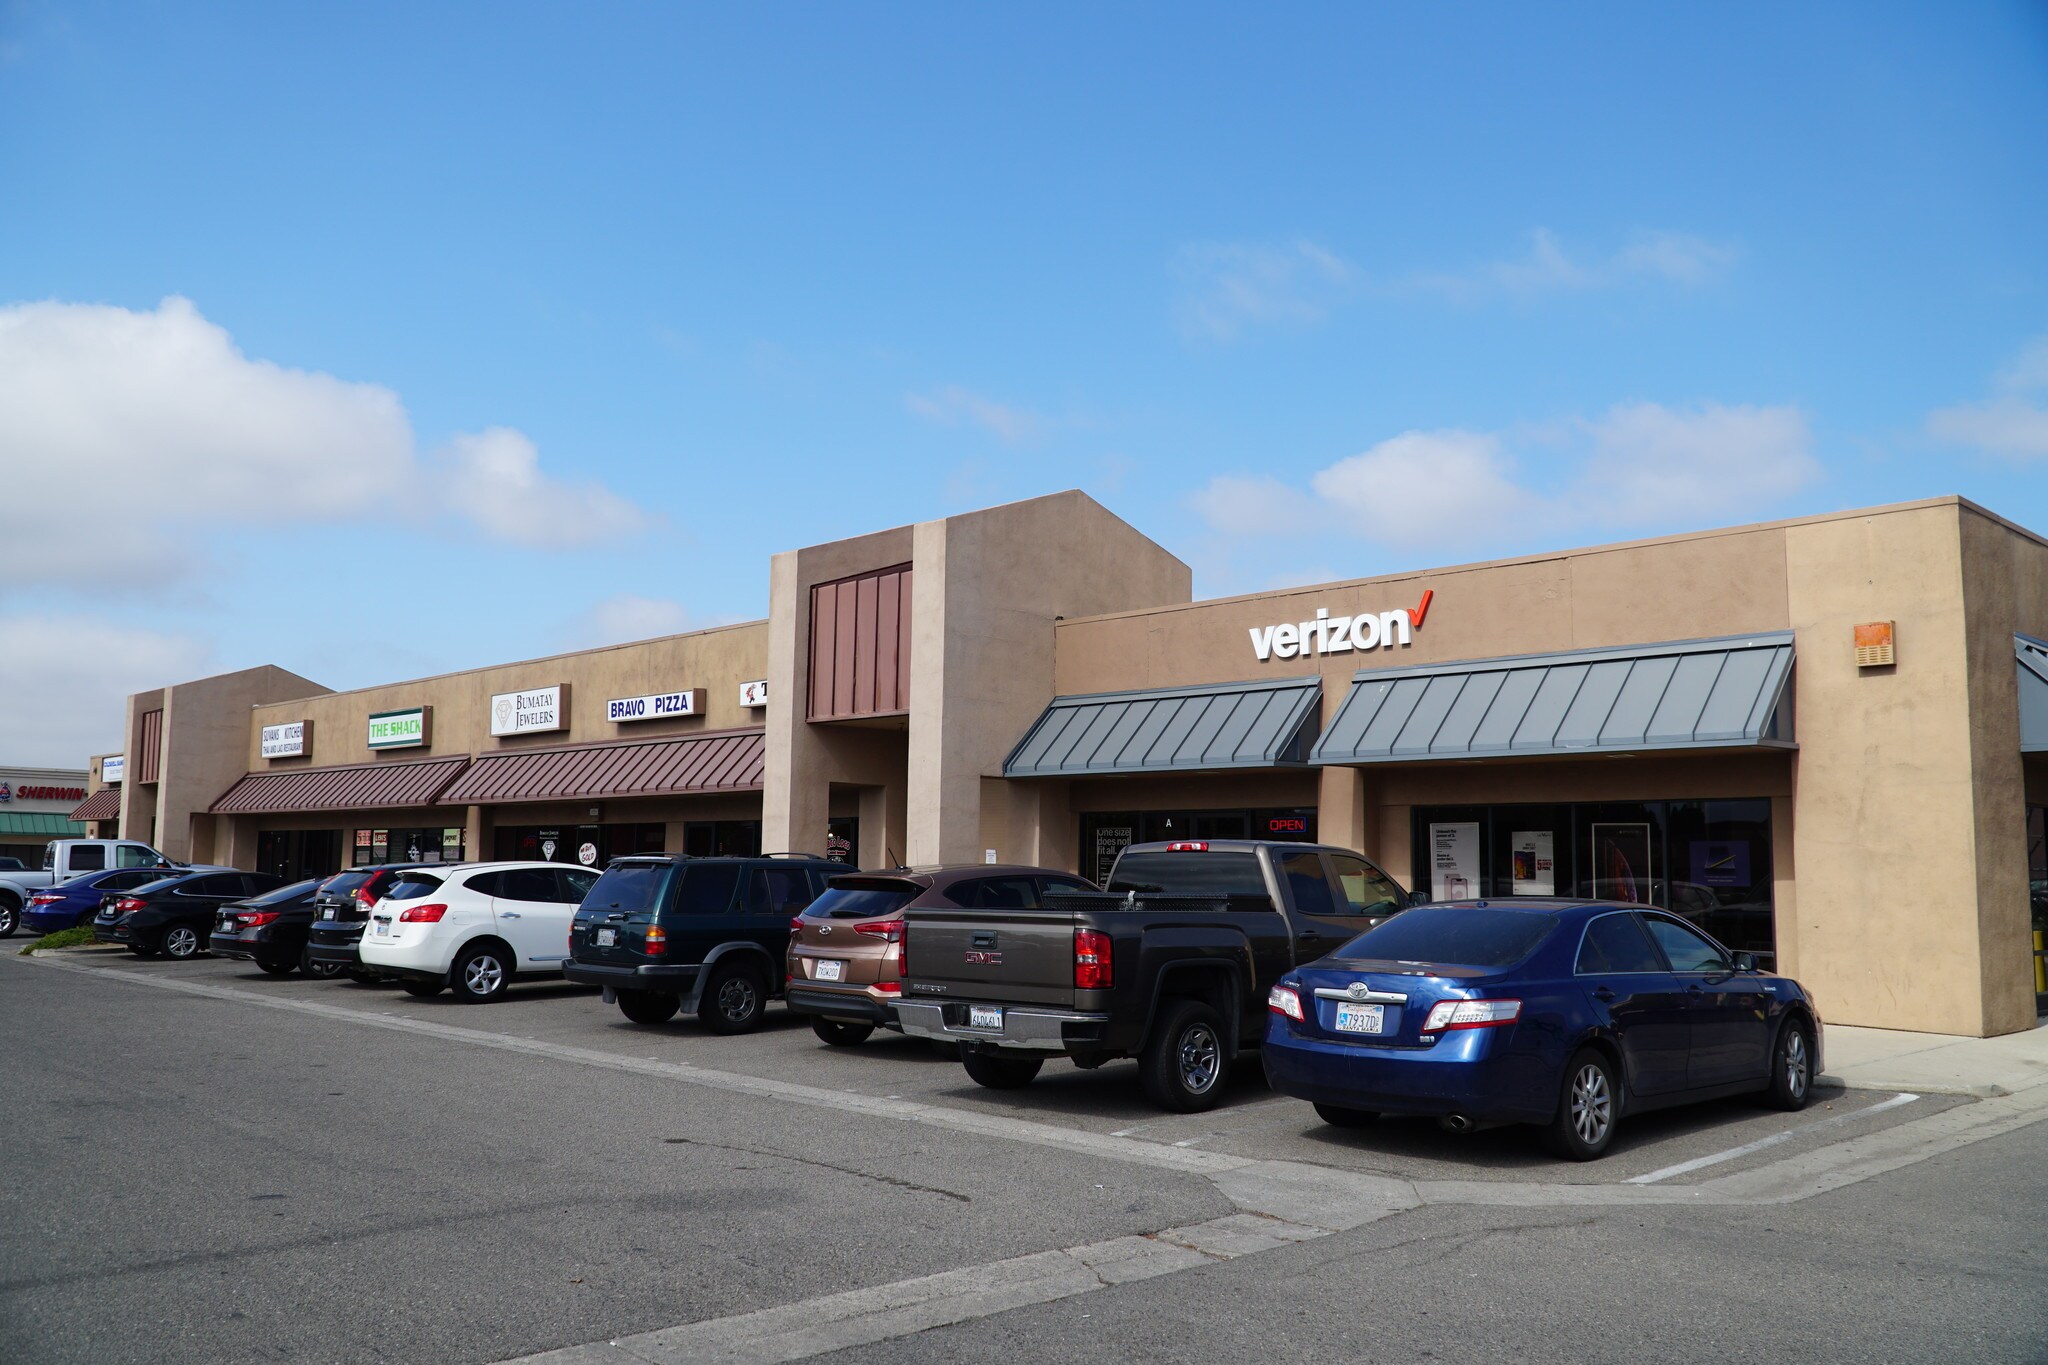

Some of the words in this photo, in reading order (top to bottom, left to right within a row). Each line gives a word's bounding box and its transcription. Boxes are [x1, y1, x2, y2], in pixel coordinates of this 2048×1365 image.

[1249, 608, 1412, 660] verizon
[516, 694, 553, 710] BUMATAY
[611, 699, 645, 718] BRAVO
[655, 694, 688, 714] PIZZA
[515, 711, 554, 730] JEWELERS
[285, 726, 303, 739] KITCHEN
[371, 723, 388, 737] THE
[390, 719, 421, 736] SHACK
[1165, 818, 1172, 828] A
[1269, 819, 1304, 831] OPEN
[1114, 829, 1130, 837] size
[1098, 837, 1116, 846] does
[582, 853, 594, 862] GOLD
[964, 951, 1002, 965] GMC
